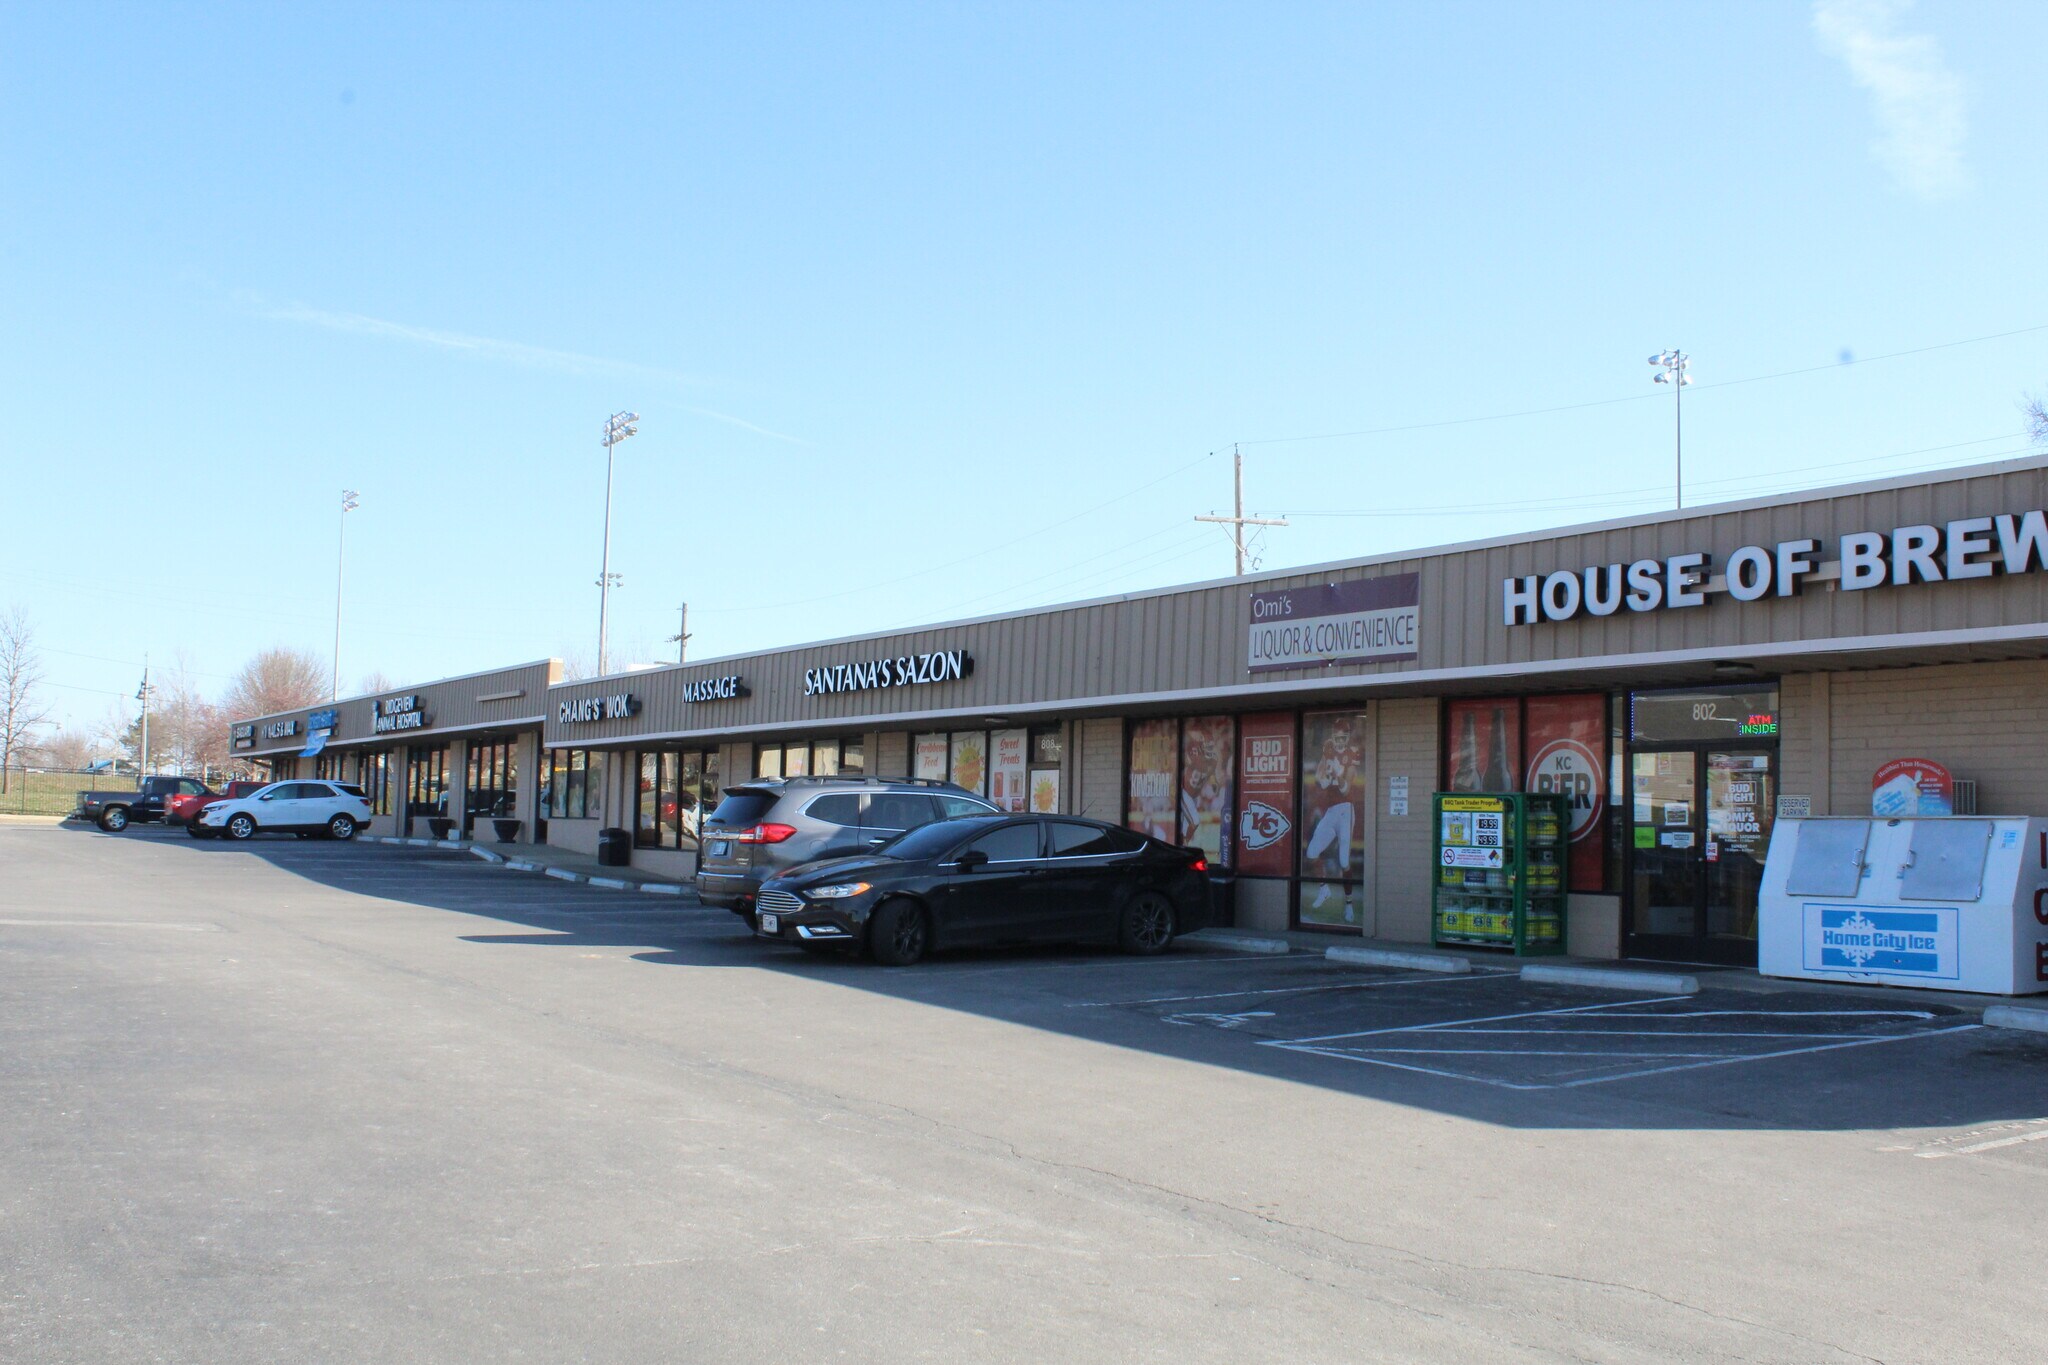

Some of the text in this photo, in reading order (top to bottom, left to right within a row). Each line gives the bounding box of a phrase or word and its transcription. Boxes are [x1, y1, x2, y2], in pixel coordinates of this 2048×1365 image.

[1503, 552, 1706, 626] HOUSE
[1725, 538, 1814, 602] OF
[1253, 595, 1292, 618] Omi's
[1253, 614, 1414, 660] LIQUOR & CONVENIENCE
[804, 649, 963, 696] SANTANA'S SAZON
[682, 675, 737, 703] MASSAGE
[385, 695, 415, 715] RIDGEVIEW
[559, 693, 629, 723] CHANG'S WOK
[1692, 703, 1716, 720] 802
[377, 711, 422, 732] ANIMAL HOSPITAL
[1748, 714, 1772, 725] ATM
[1741, 723, 1777, 734] INSIDE
[1000, 738, 1020, 750] Sweet
[1041, 738, 1054, 750] 808
[1252, 740, 1282, 756] BUD
[999, 753, 1021, 766] Treats
[1246, 756, 1287, 772] LIGHT
[1555, 756, 1572, 770] KC
[1878, 762, 1900, 778] Healthier
[1913, 760, 1945, 778] Homemade!
[1130, 772, 1171, 797] KINGDOM
[1729, 783, 1750, 793] BUD
[1480, 799, 1500, 807] Program
[1724, 793, 1755, 803] LIGHT
[1779, 798, 1810, 807] RESERVED
[1726, 812, 1755, 822] OMI'S
[1782, 808, 1808, 816] PARKING
[1251, 811, 1279, 838] KC
[1722, 822, 1761, 832] IQUOR
[1823, 930, 1935, 951] Home City Ice
